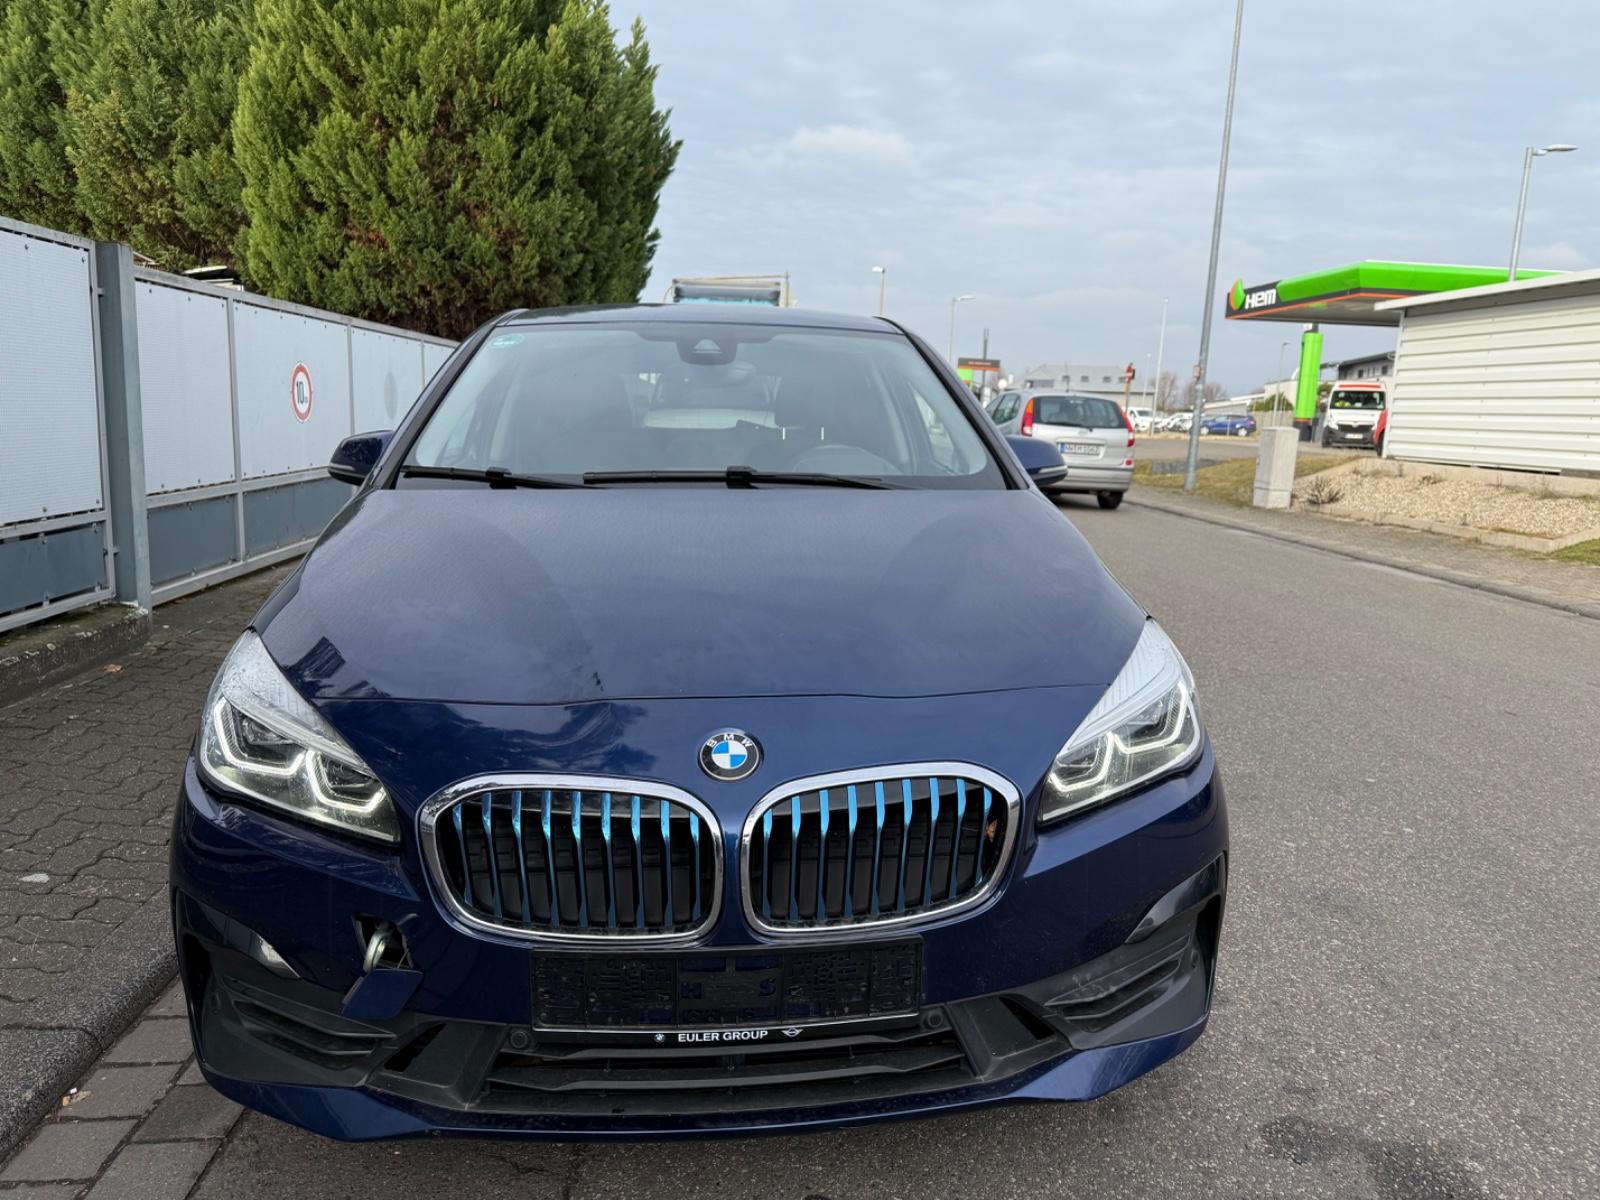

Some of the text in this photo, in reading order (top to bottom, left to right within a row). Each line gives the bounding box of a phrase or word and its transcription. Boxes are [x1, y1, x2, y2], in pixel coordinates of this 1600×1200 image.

[296, 381, 304, 404] 10
[706, 733, 753, 748] BMW
[677, 1032, 720, 1042] EULER
[722, 1030, 768, 1041] GROUP
